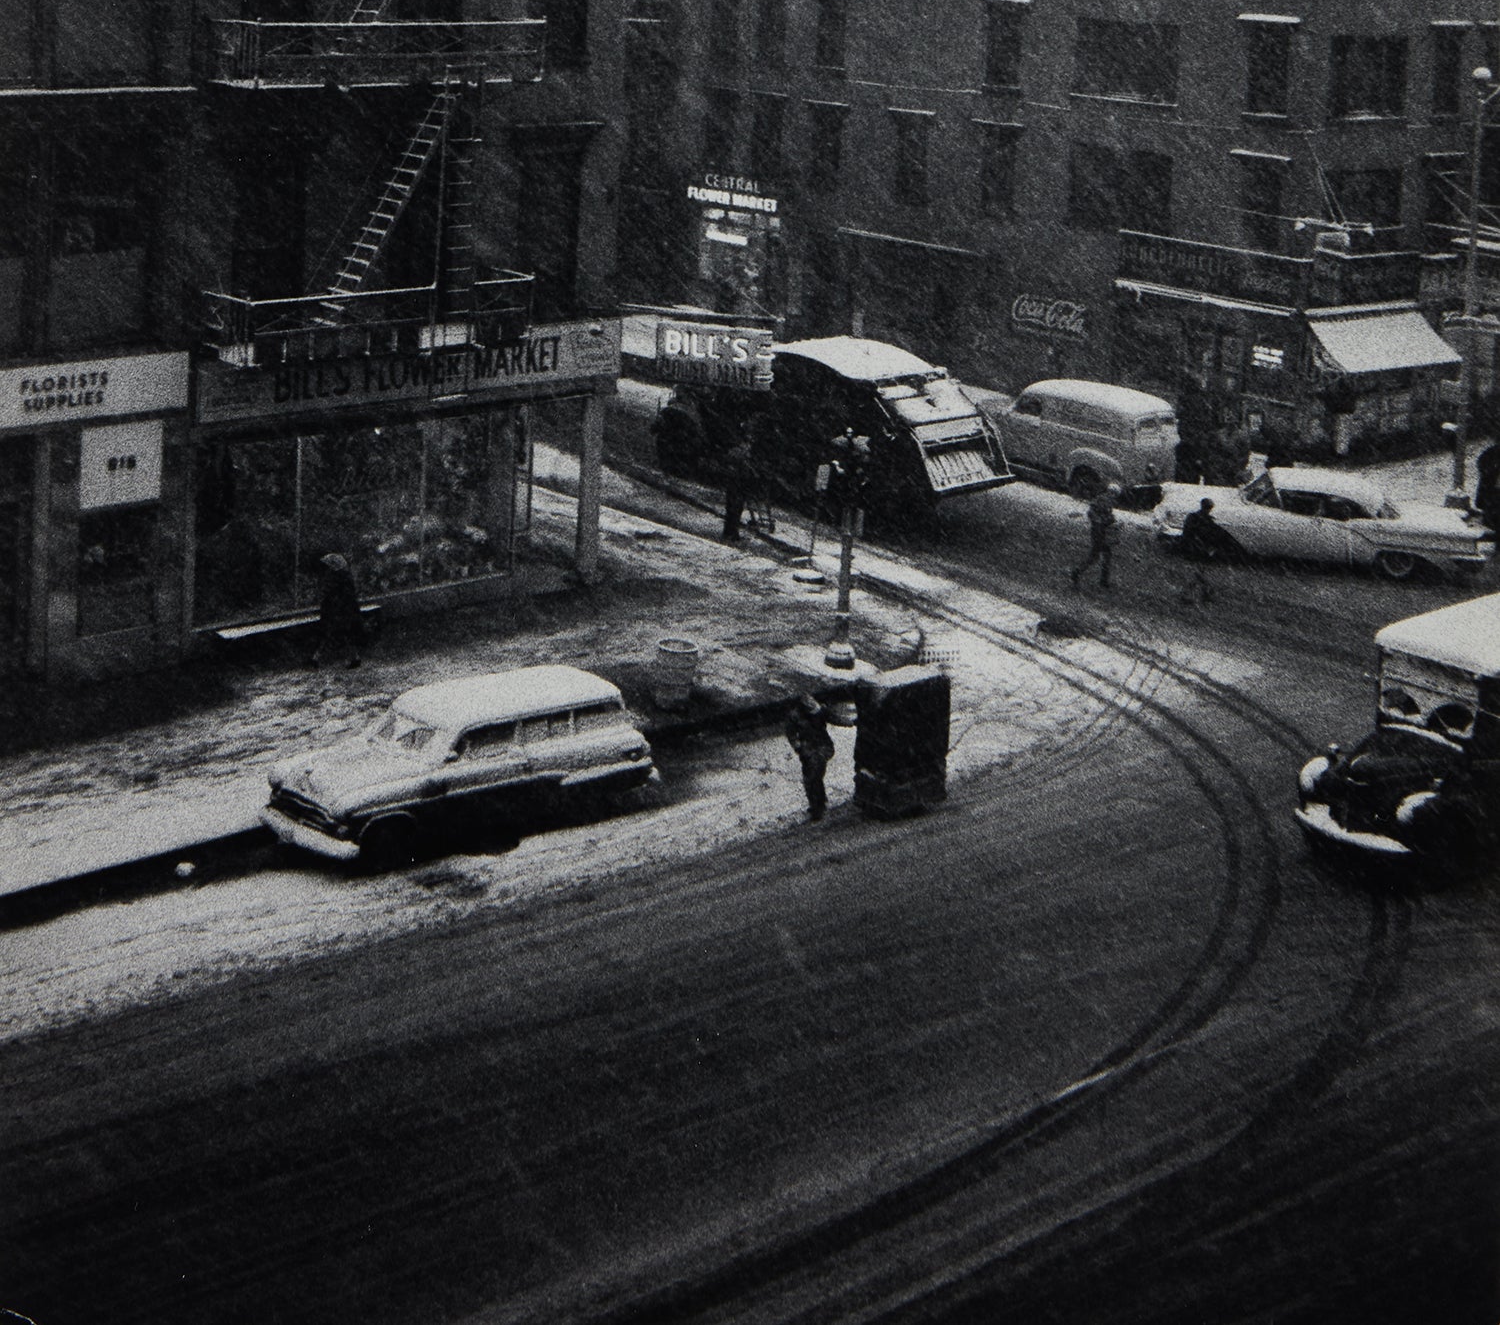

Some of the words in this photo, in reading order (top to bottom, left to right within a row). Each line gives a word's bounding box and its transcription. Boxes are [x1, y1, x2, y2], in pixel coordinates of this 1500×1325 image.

[704, 173, 761, 194] CENTRAL
[687, 186, 730, 206] FLOWER
[732, 193, 777, 213] MARKET
[665, 330, 750, 363] BILL'S
[364, 352, 462, 392] FLOWER
[474, 336, 561, 380] MARKET
[20, 371, 109, 394] FLORISTS
[23, 390, 105, 412] SUPPLIES
